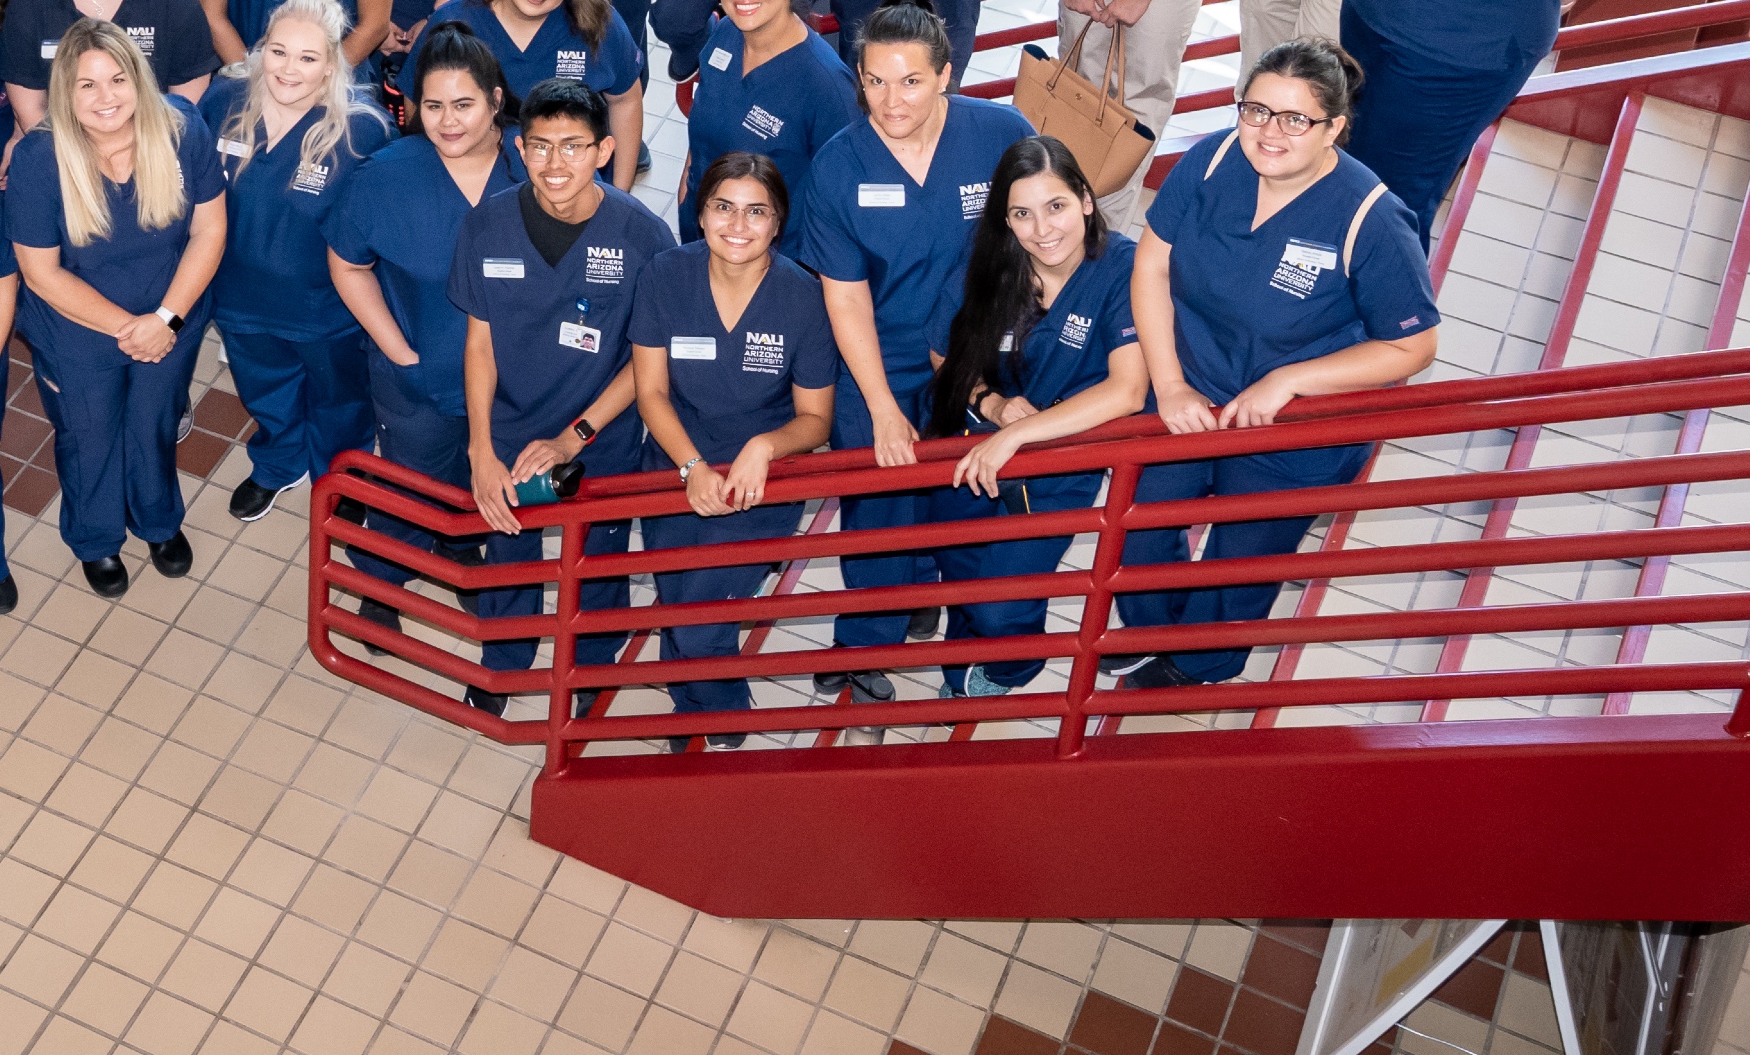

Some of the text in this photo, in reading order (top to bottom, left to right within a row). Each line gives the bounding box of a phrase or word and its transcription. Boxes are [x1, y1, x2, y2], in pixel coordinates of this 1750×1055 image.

[127, 27, 154, 35] NAU
[558, 51, 585, 59] NAU
[747, 114, 771, 131] UNIVERSITY
[749, 110, 773, 127] ARIZONA
[753, 104, 784, 126] NORTHERN
[587, 247, 623, 259] NAU
[1276, 268, 1314, 287] ARIZONA
[1279, 262, 1317, 281] NORTHERN
[1274, 273, 1313, 291] UNIVERSITY
[746, 332, 784, 346] NAU
[744, 351, 783, 359] ARIZONA
